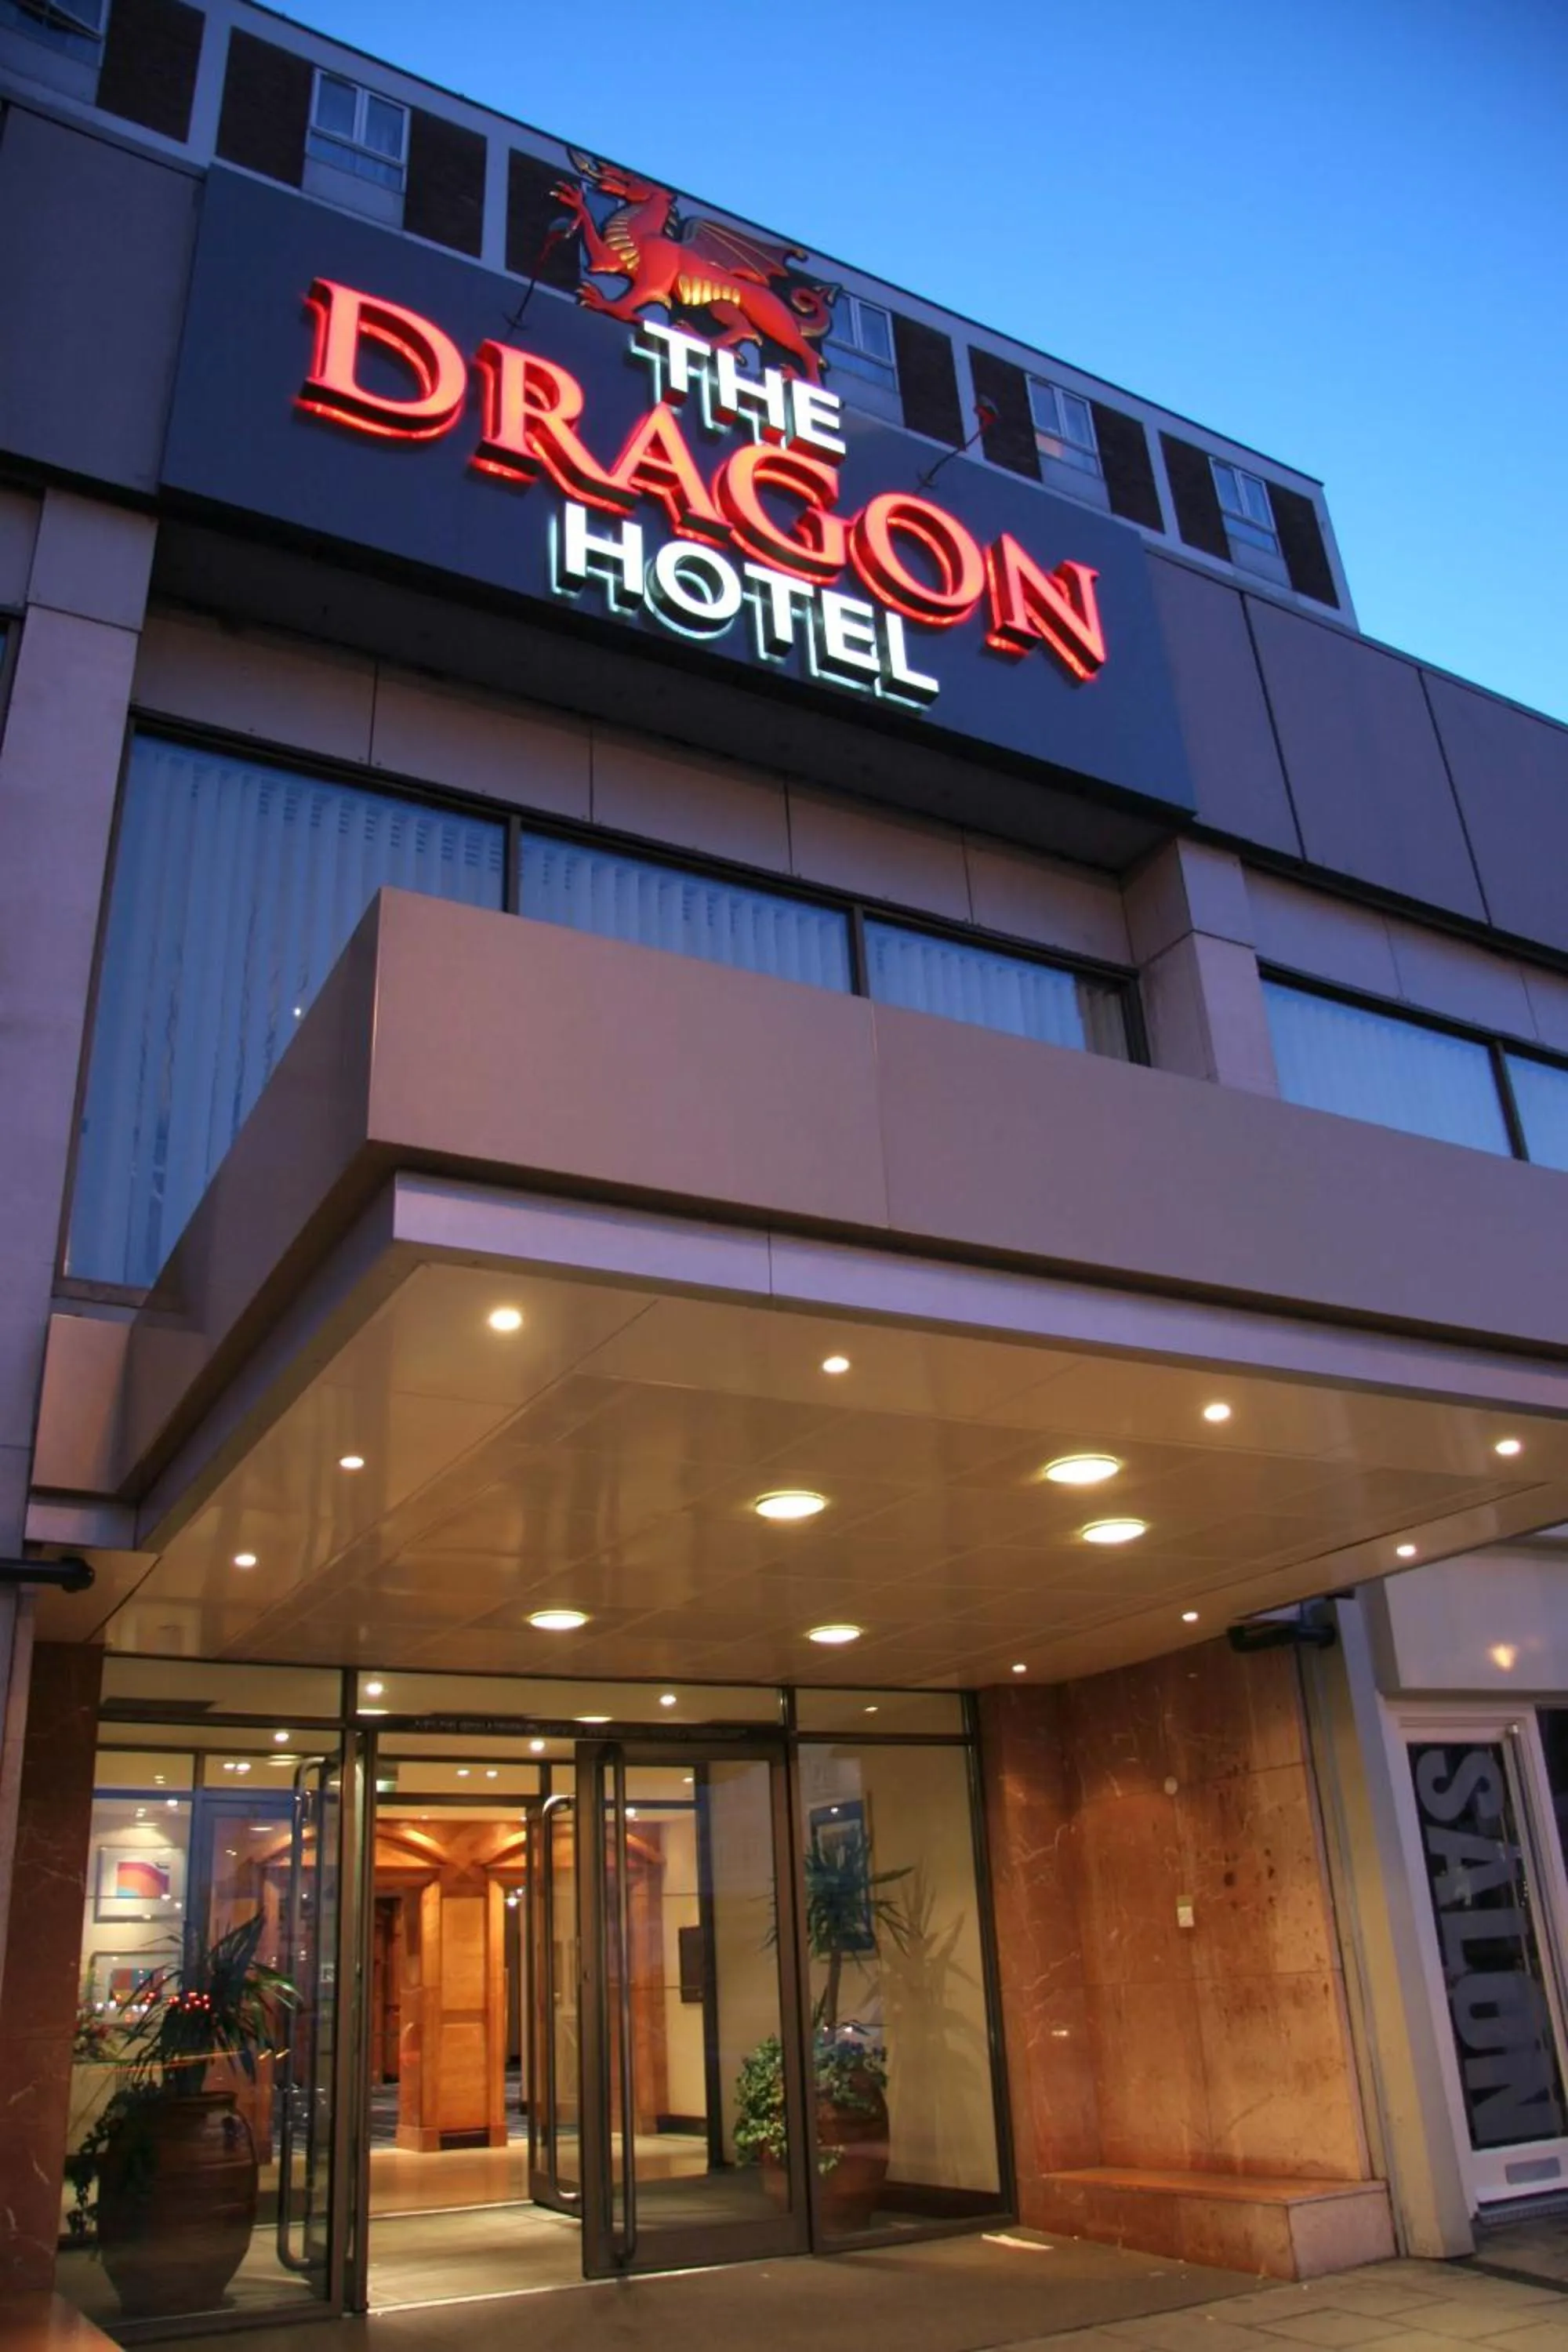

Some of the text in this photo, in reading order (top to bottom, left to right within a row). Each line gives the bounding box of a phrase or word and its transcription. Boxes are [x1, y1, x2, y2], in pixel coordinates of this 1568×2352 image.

[295, 278, 1107, 681] DRAGON
[633, 318, 847, 459] THE
[551, 502, 940, 710] HOTEL
[1416, 1749, 1562, 2142] SALON
